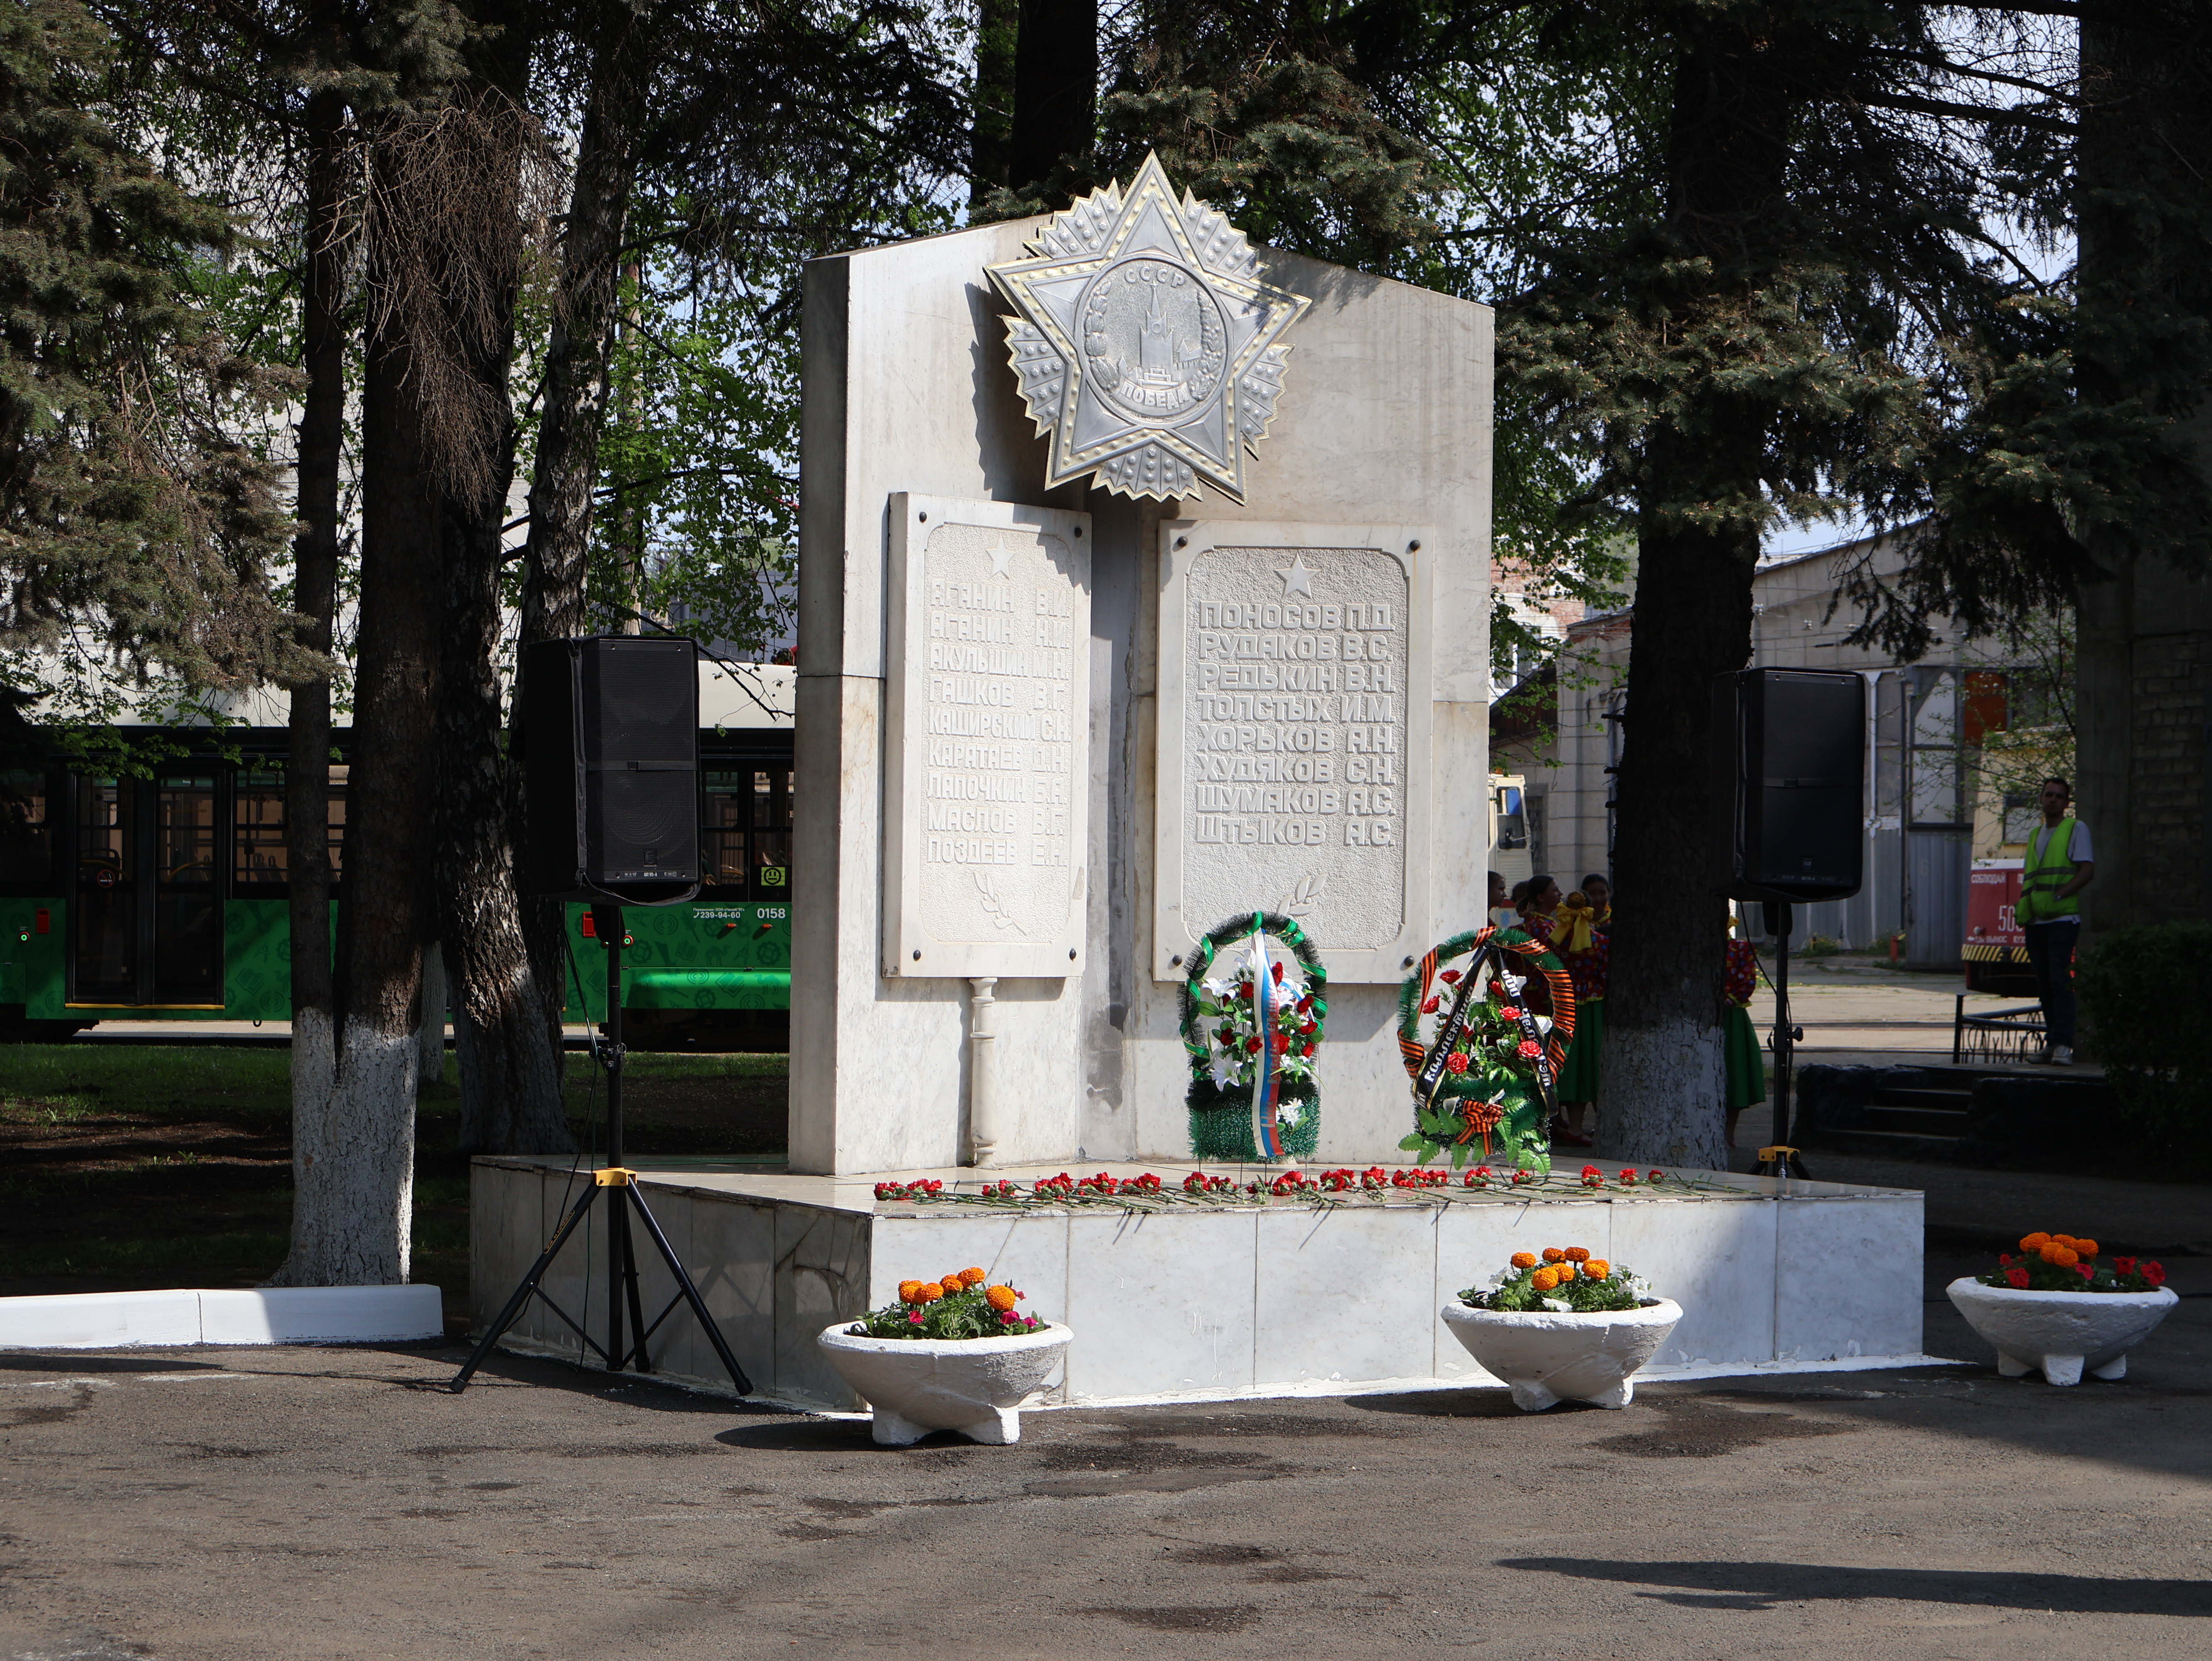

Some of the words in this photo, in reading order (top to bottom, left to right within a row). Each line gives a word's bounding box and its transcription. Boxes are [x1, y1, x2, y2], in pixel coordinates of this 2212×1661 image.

[1124, 265, 1185, 289] СССР
[1120, 380, 1190, 410] ПОБЕДА
[931, 578, 1014, 613] АГАНИН
[930, 611, 1013, 644] АГАНИН
[1199, 600, 1341, 630] ПОНОСОВ
[1198, 631, 1336, 660] РУДАКОВ
[929, 643, 1028, 678] АКУЛЬШИН
[928, 674, 1015, 707] ГАШКОВ
[1197, 663, 1336, 691] РЕДЬКИН
[1197, 693, 1331, 721] ТОЛСТЫХ
[928, 706, 1035, 740] КАШИРСКИЙ
[1196, 724, 1335, 752] ХОРЬКОВ
[928, 739, 1023, 770] КАРАТАЕВ
[1196, 755, 1334, 782] ХУДЯКОВ
[927, 771, 1026, 803] ЛАПОЧКИН
[1196, 785, 1340, 813] ШУМАКОВ
[927, 802, 1017, 833] МАСЛОВ
[1195, 816, 1327, 845] ШТЫКОВ
[927, 835, 1018, 865] ПОЗДЕЕВ
[1971, 872, 2006, 884] СОБЛЮДАЙ
[757, 908, 785, 919] 0158
[1998, 905, 2023, 932] 50
